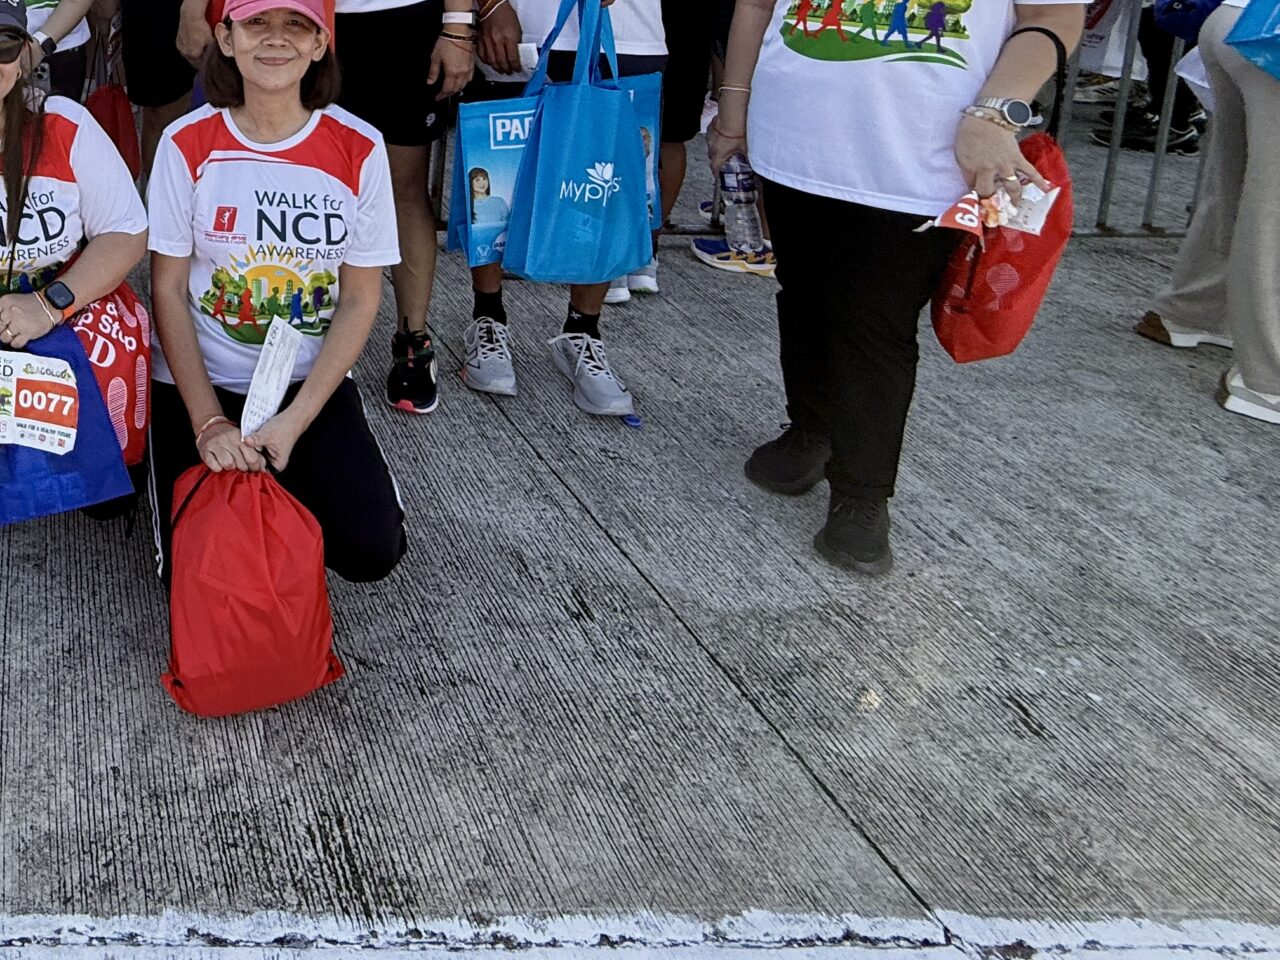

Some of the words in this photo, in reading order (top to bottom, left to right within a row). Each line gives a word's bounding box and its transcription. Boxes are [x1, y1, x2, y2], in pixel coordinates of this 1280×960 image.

[31, 190, 55, 208] for
[254, 190, 318, 210] WALK
[256, 208, 348, 246] NCD
[255, 244, 344, 260] AWARENESS
[18, 389, 75, 416] 0077
